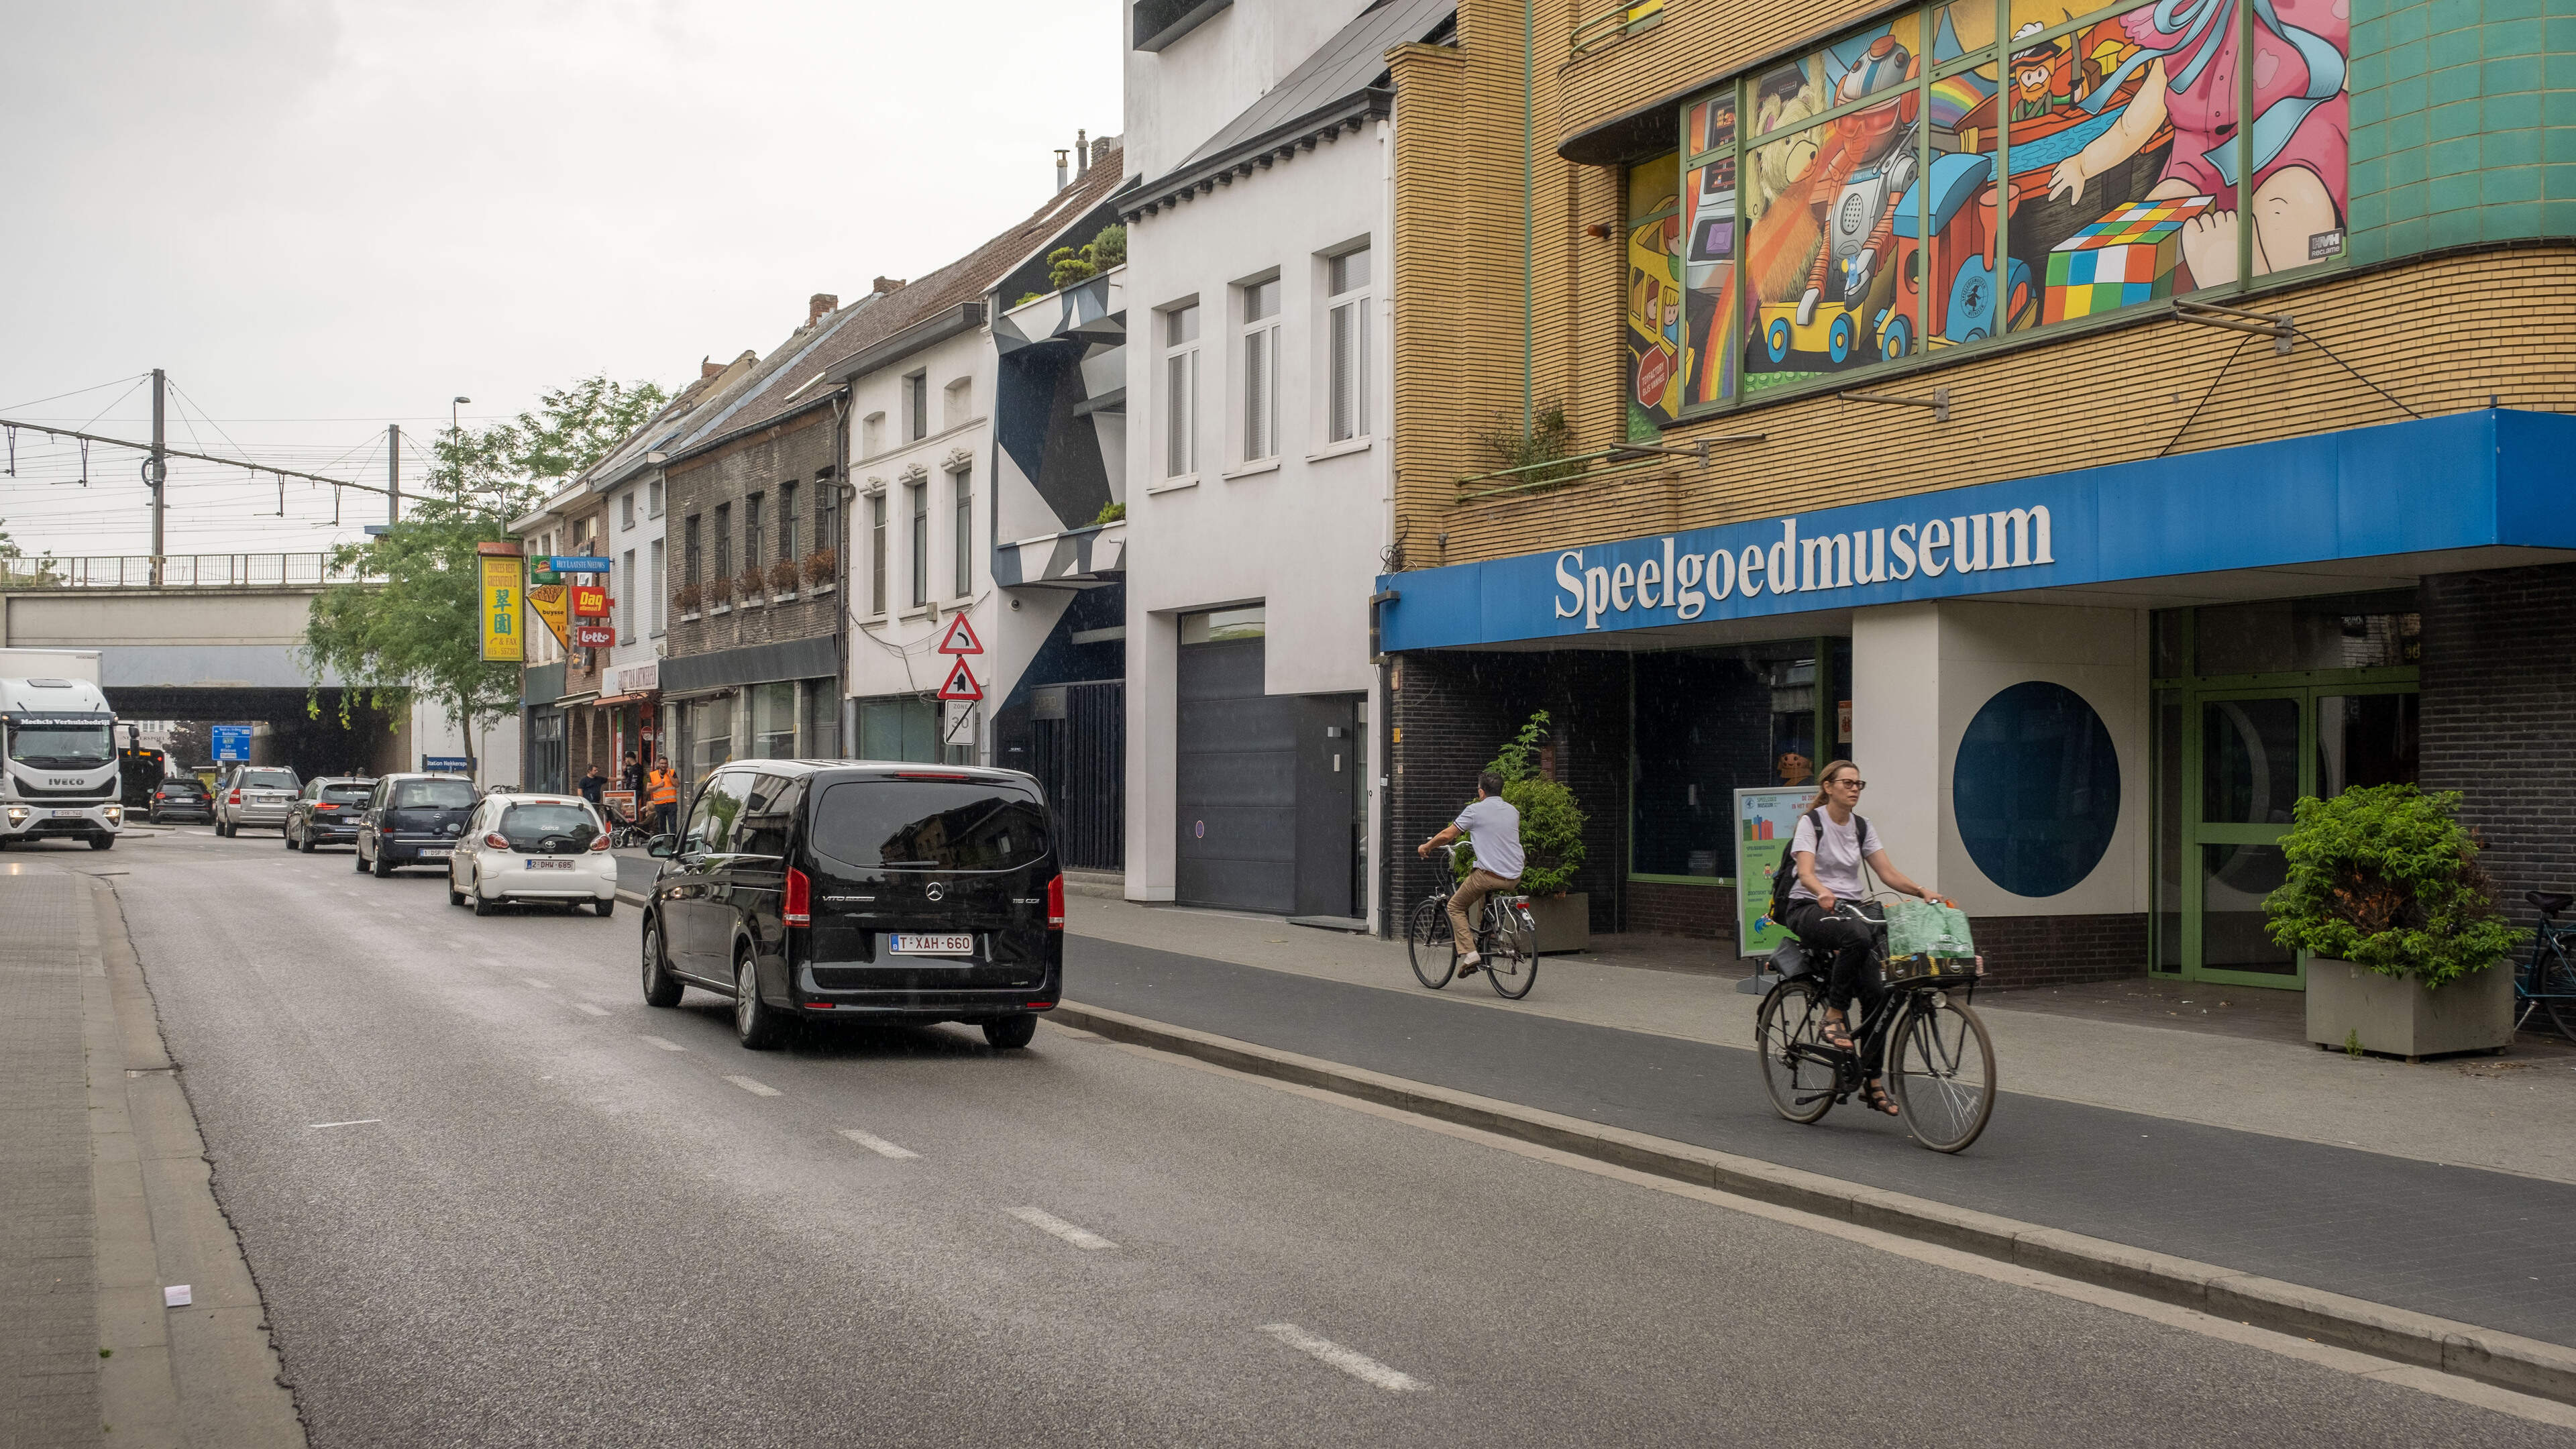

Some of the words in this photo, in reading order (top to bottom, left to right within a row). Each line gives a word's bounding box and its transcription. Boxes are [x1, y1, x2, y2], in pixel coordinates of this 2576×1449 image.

[1642, 361, 1664, 386] TOYFACTORY
[488, 563, 504, 573] CHINEES
[567, 560, 586, 568] LAATSTE
[587, 560, 605, 569] NIEUWS
[1555, 504, 2054, 629] Speelgoedmuseum
[488, 575, 513, 587] GREENFIELD
[580, 592, 603, 611] Dag
[581, 631, 609, 643] Lotto
[951, 716, 969, 729] 30
[443, 760, 468, 769] Nekkersp
[900, 937, 969, 949] T-XAH-660
